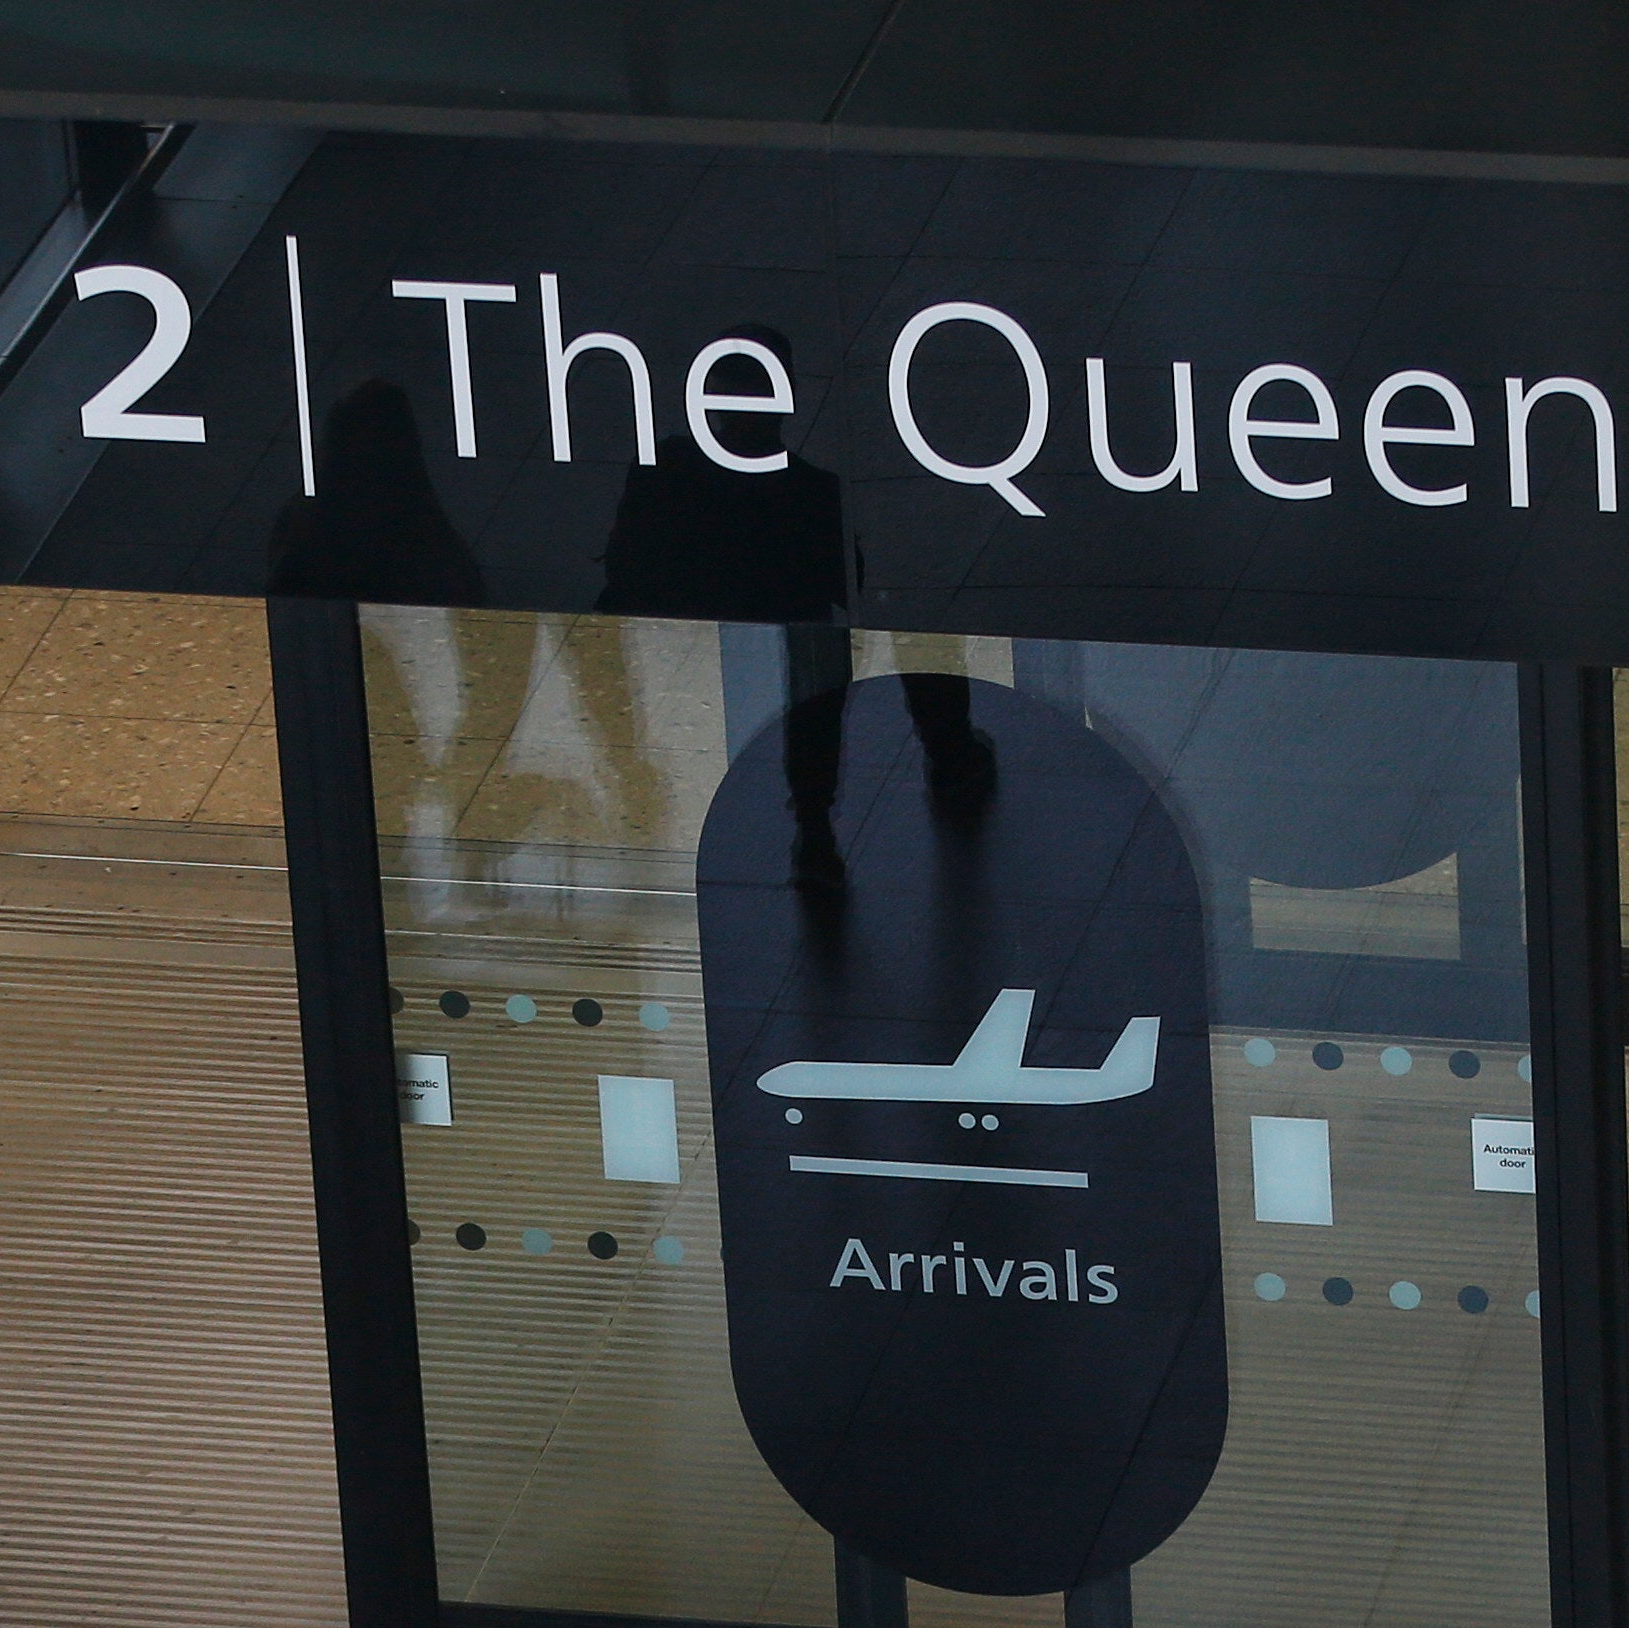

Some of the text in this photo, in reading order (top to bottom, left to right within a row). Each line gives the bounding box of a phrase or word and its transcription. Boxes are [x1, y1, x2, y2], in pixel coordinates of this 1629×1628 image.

[73, 263, 208, 442] 2
[390, 273, 795, 472] The
[1499, 1158, 1526, 1169] door
[829, 1238, 1119, 1305] Arrivals
